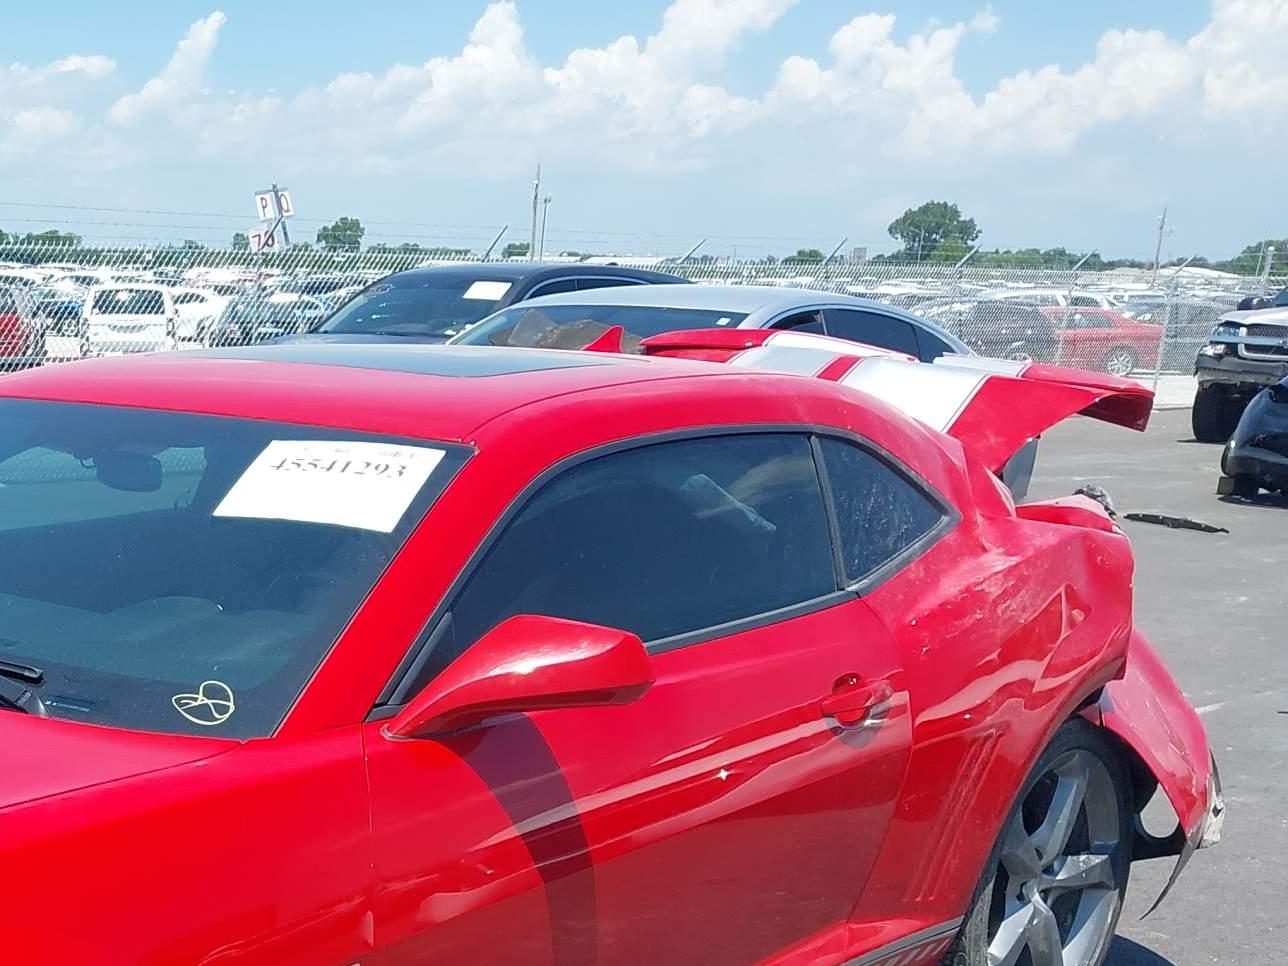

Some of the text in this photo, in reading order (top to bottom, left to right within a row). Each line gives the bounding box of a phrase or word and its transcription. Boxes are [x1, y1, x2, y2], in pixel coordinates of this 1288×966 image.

[260, 196, 268, 217] P
[279, 193, 291, 213] Q
[270, 458, 407, 478] 45541293
